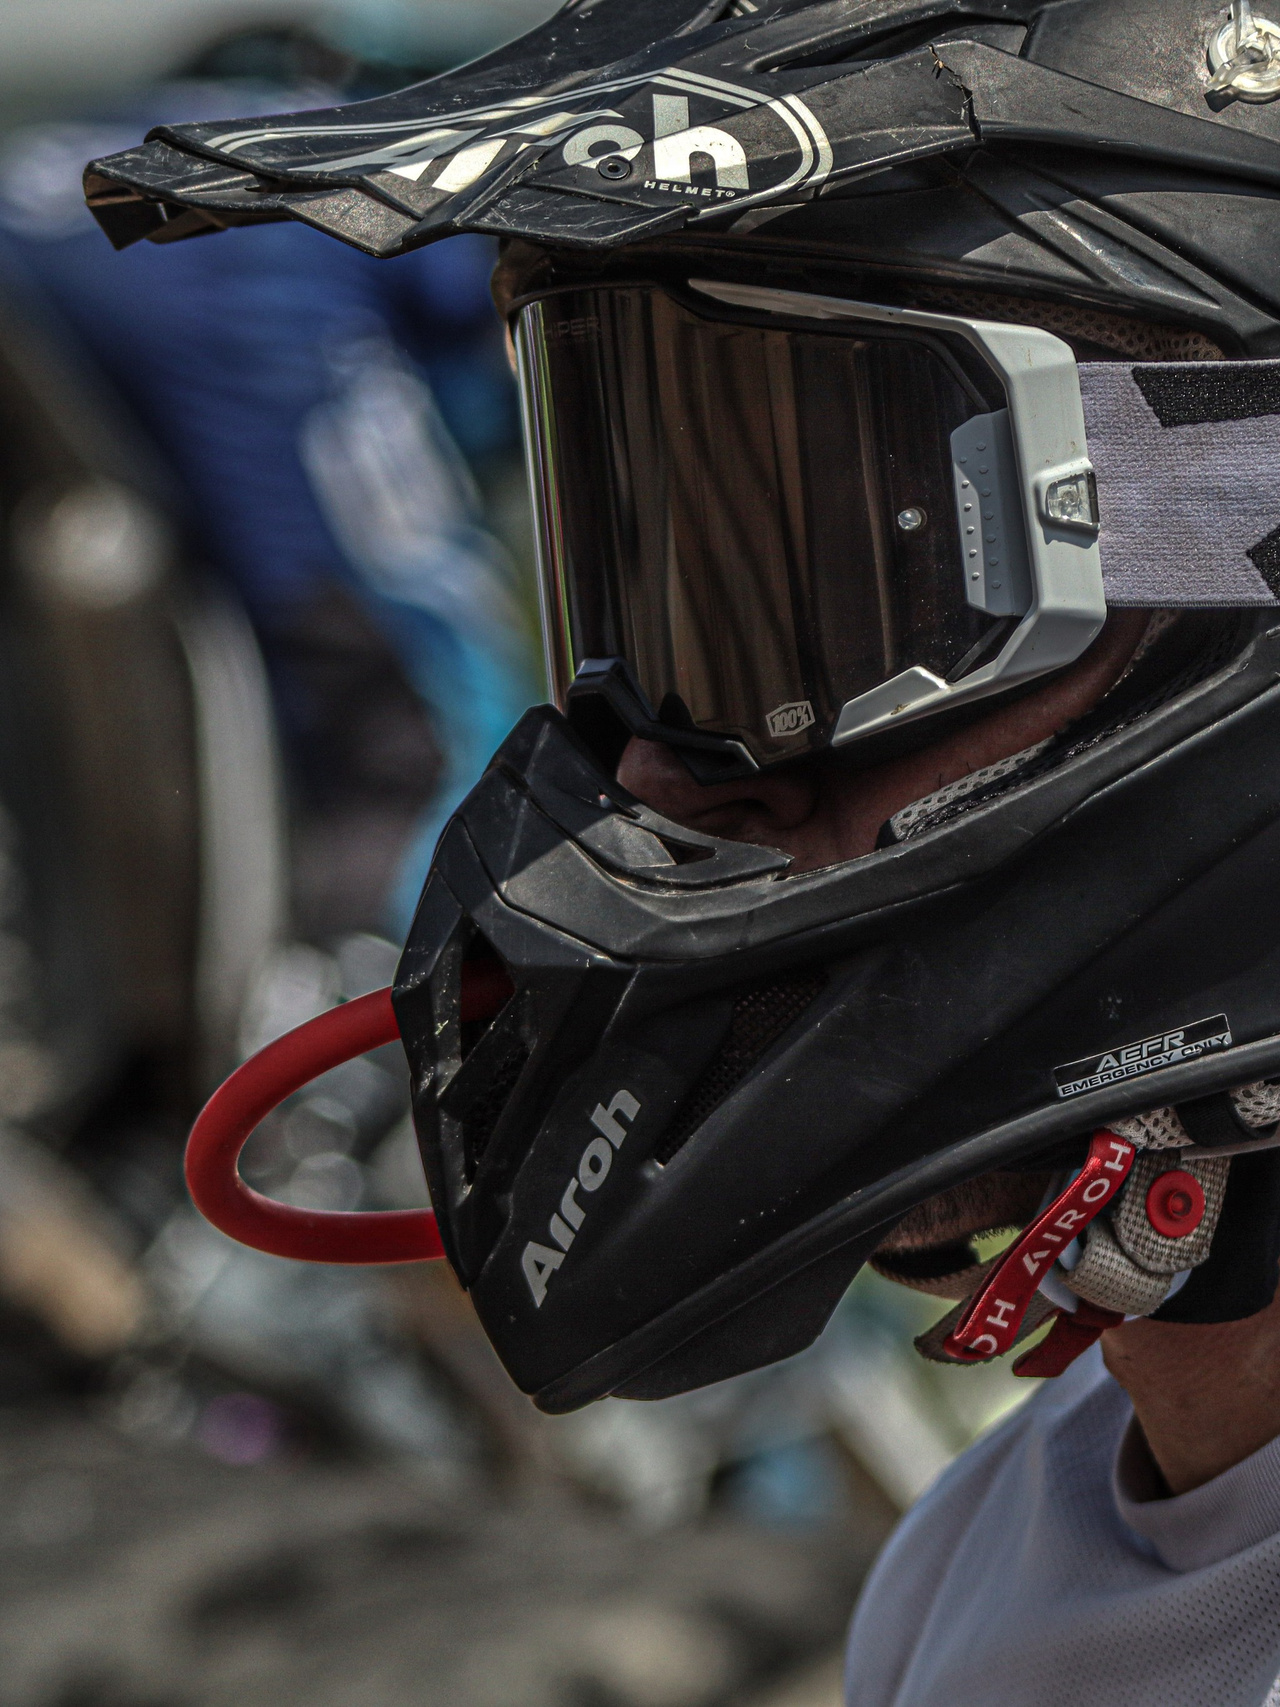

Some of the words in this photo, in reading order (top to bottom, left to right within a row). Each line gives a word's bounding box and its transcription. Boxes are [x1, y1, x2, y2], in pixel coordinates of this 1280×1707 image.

[772, 705, 809, 734] 100%
[1061, 1052, 1174, 1096] EMERGENCY
[1181, 1034, 1229, 1058] ONLY
[1096, 1030, 1186, 1073] AEFR
[1021, 1141, 1132, 1277] AIROH
